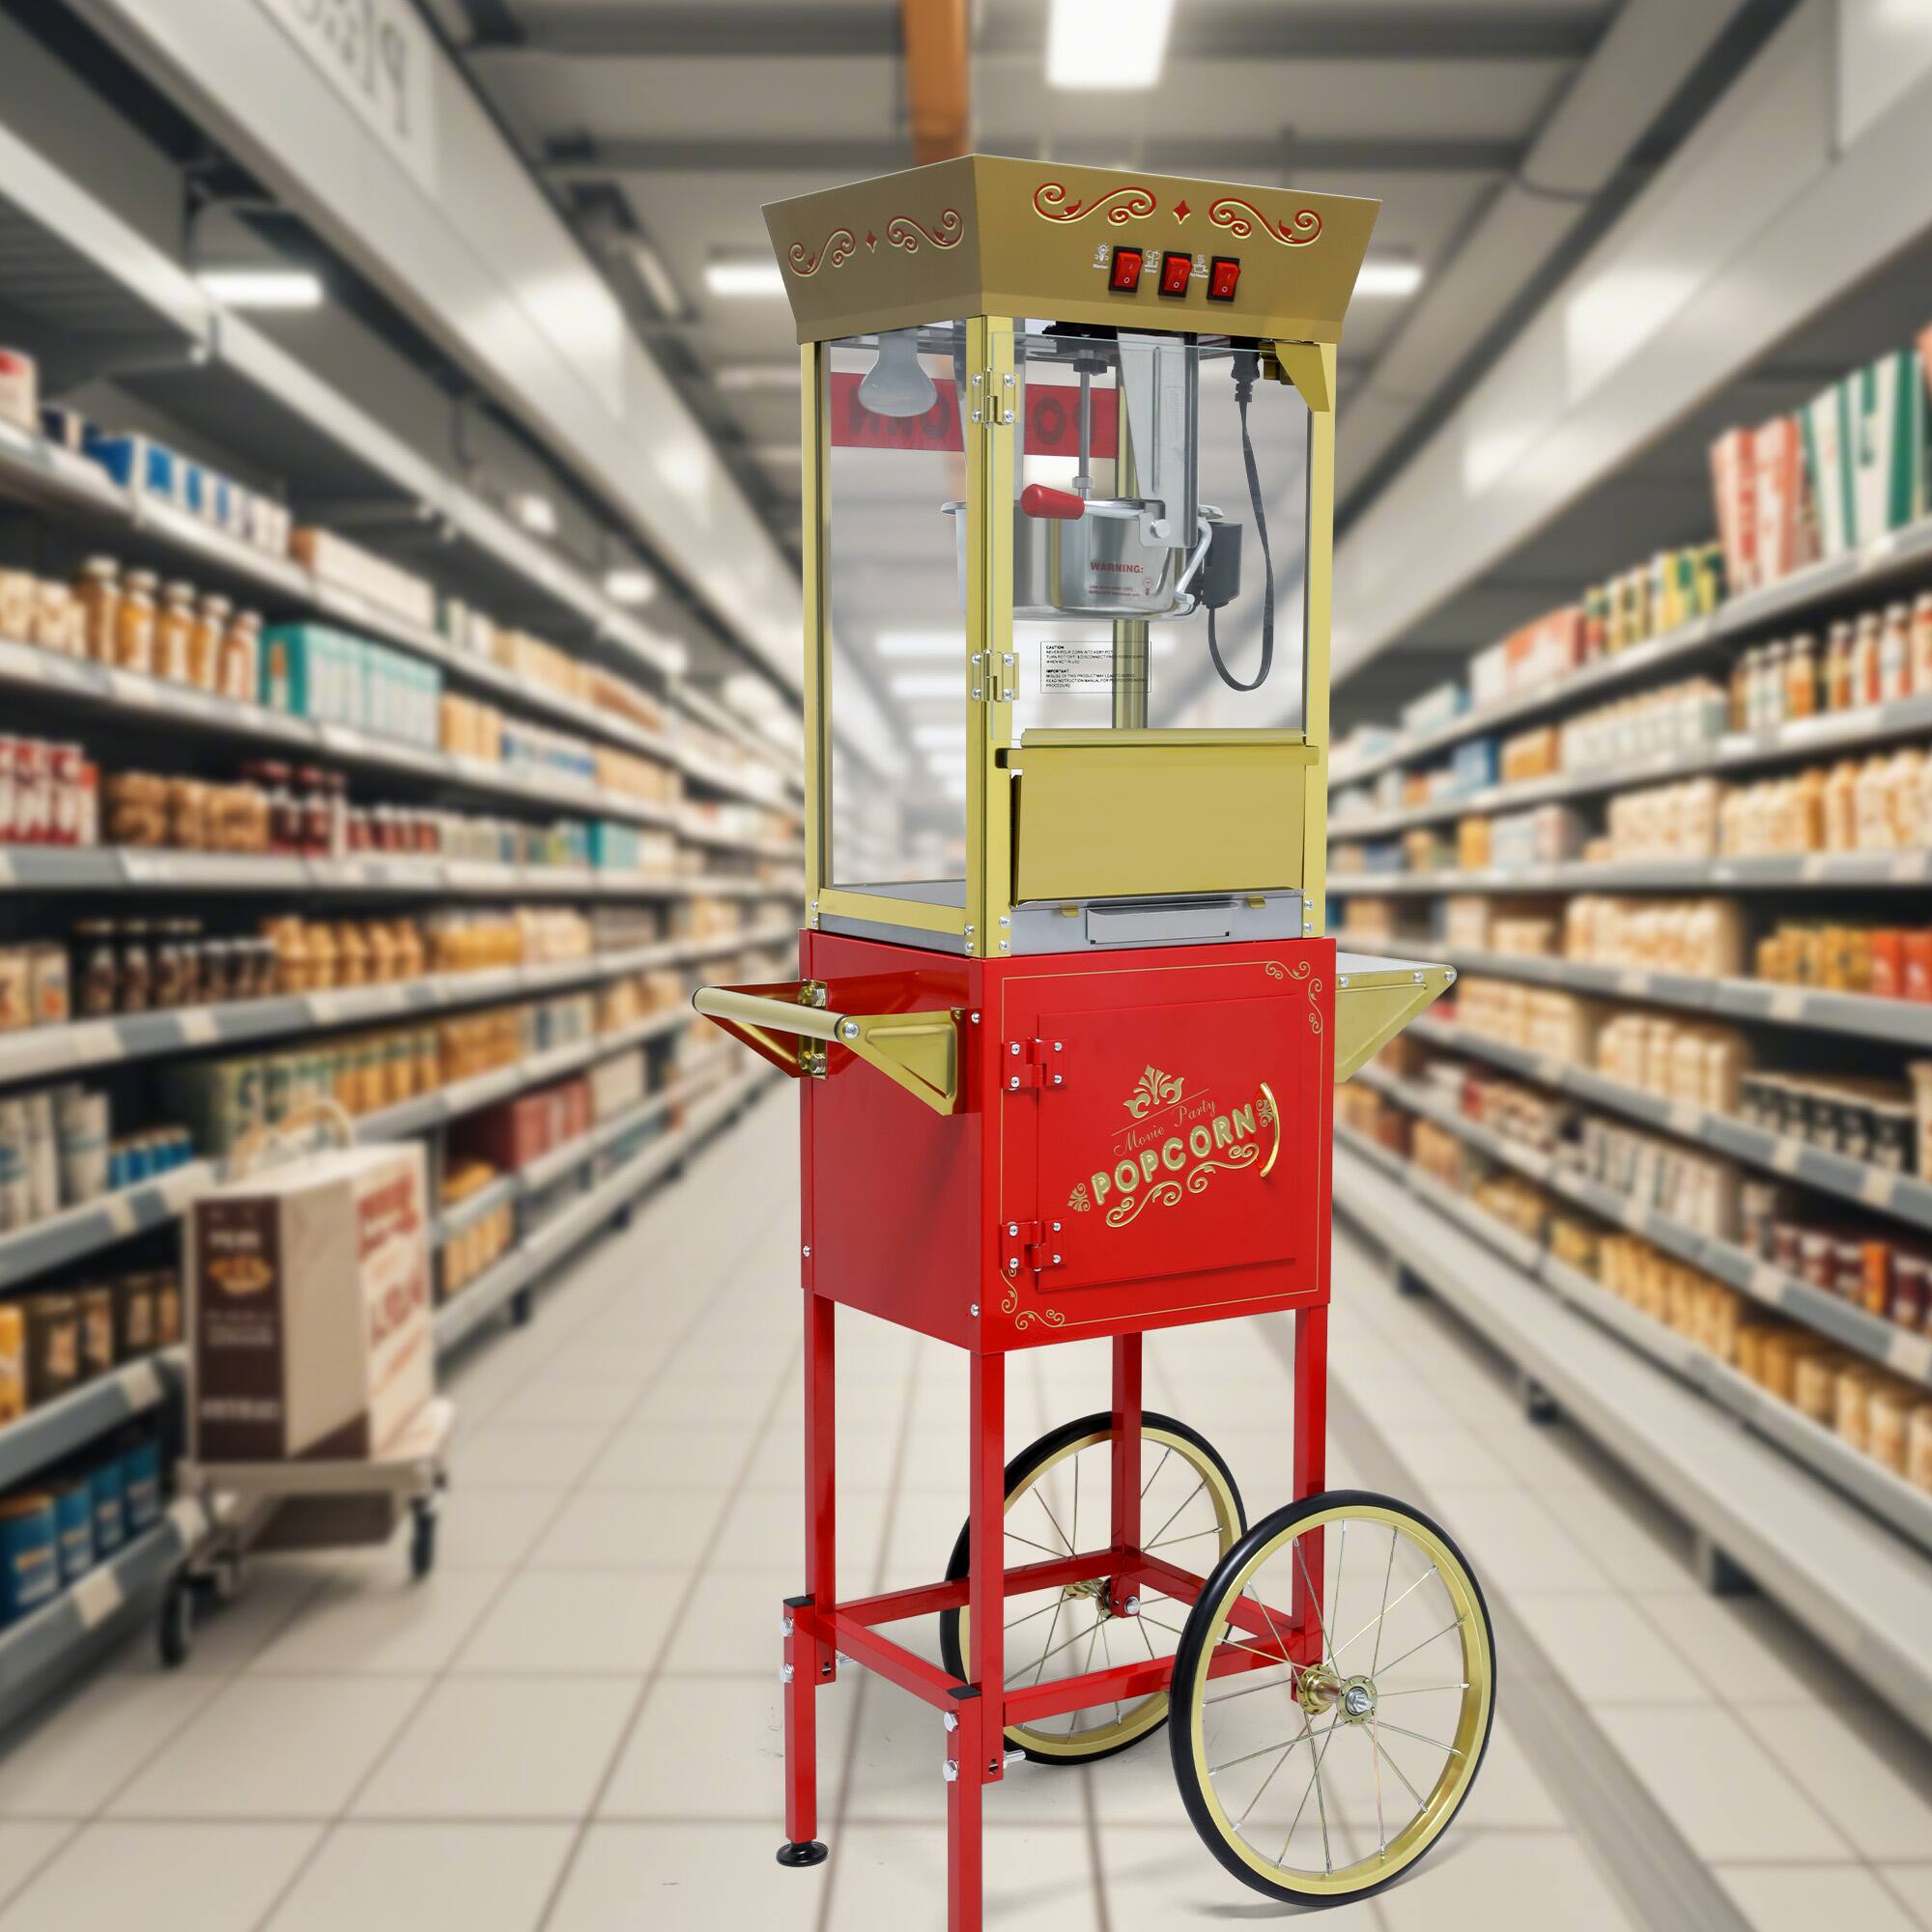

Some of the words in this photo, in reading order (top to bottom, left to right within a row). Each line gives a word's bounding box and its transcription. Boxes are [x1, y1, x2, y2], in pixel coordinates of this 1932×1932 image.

[1090, 562, 1144, 574] WARNING:
[1091, 1103, 1256, 1206] POPCORN
[1114, 1125, 1165, 1157] Movie
[1172, 1099, 1216, 1127] Party
